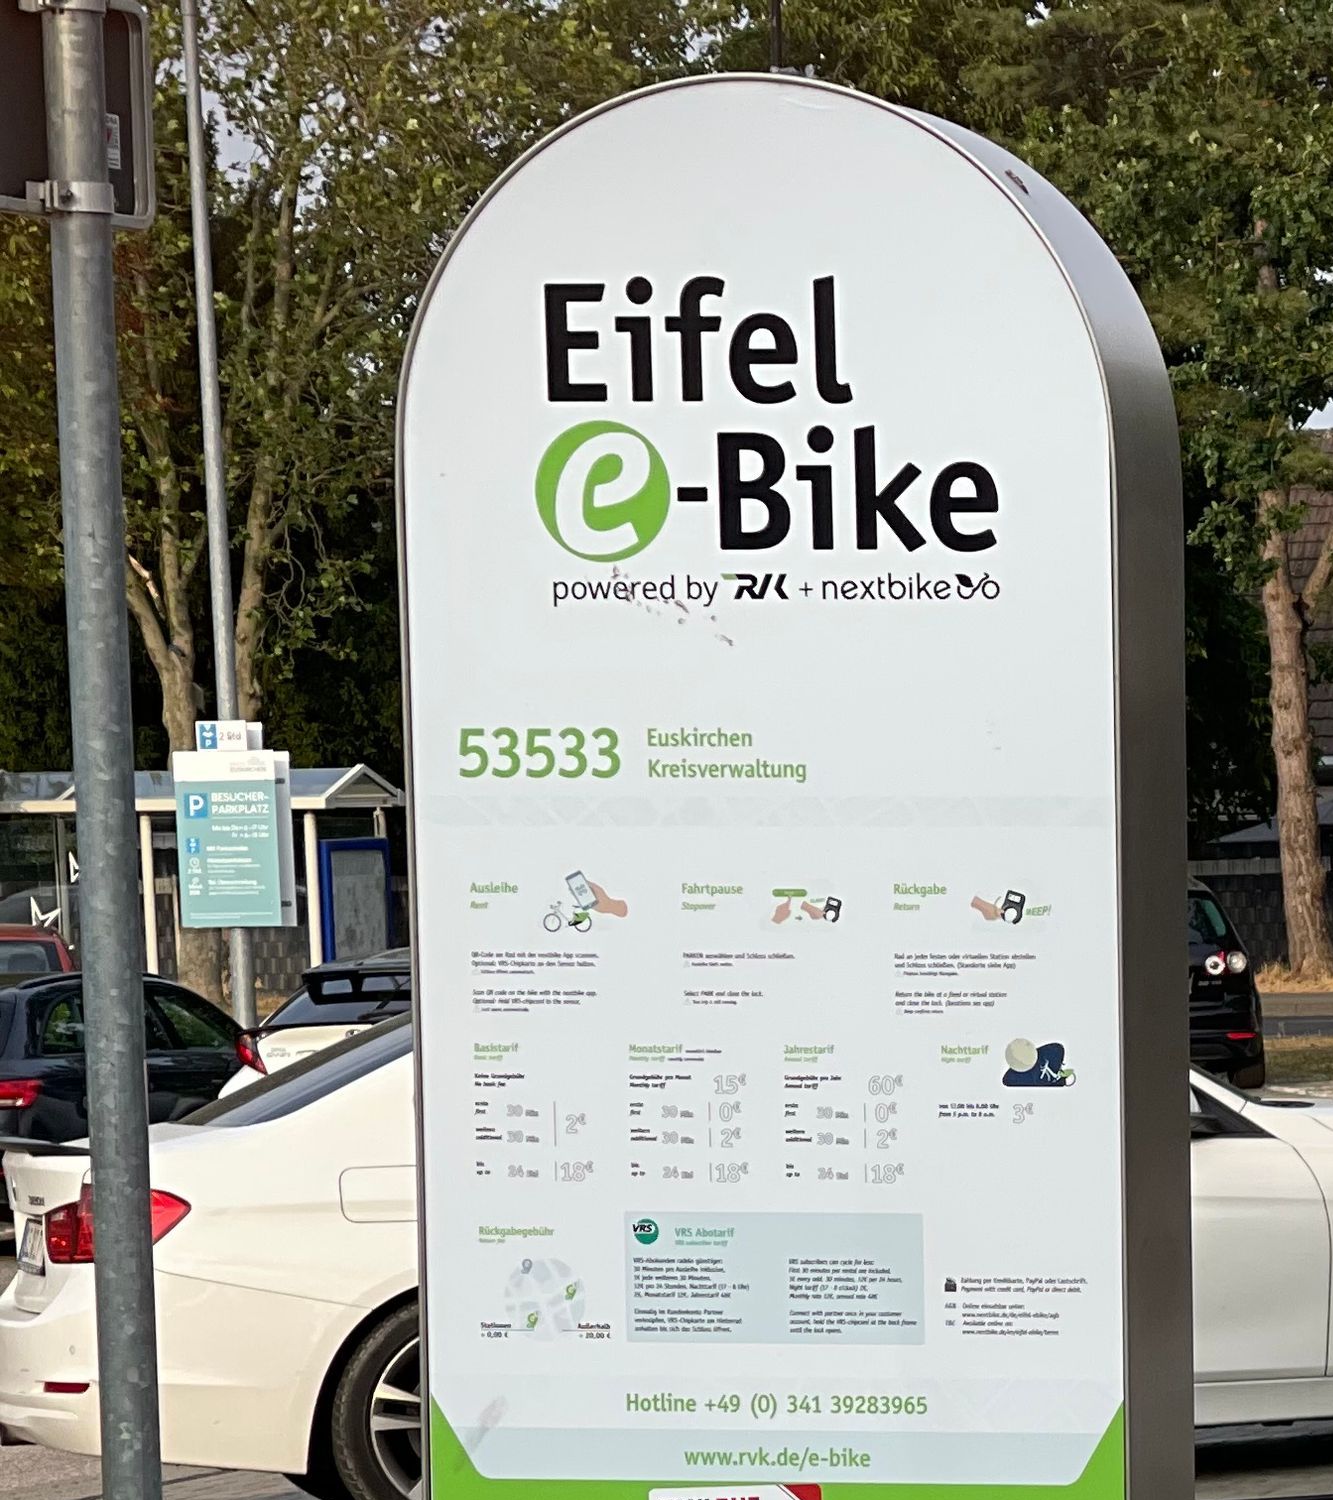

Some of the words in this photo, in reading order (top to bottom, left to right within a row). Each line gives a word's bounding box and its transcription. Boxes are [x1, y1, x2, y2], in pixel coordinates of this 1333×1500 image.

[544, 275, 852, 404] Eifel
[535, 420, 999, 562] e-Bike
[553, 576, 675, 605] powered
[686, 575, 718, 606] by
[800, 582, 812, 596] +
[821, 574, 951, 601] nextbike
[219, 732, 224, 740] 2
[647, 728, 752, 748] Euskirchen
[458, 728, 621, 779] 53533
[648, 759, 807, 782] Kreisverwaltung
[211, 792, 269, 802] BESUCHER-
[189, 794, 204, 816] P
[212, 804, 269, 814] PARKPLATZ
[470, 882, 518, 894] Ausleihe
[682, 883, 743, 896] Fahrtpause
[894, 883, 947, 897] Rückgabe
[474, 1043, 518, 1052] Basistarif
[629, 1044, 682, 1053] Monatstarif
[784, 1045, 834, 1054] Jahrestarif
[941, 1045, 989, 1054] Nachttarif
[479, 1227, 554, 1237] Rückgabegebühr
[632, 1224, 652, 1232] VRS
[675, 1228, 692, 1237] VRS
[695, 1228, 734, 1237] Abotarif
[626, 1393, 696, 1412] Hotline
[705, 1395, 740, 1413] +49
[750, 1393, 777, 1418] (0)
[787, 1395, 821, 1413] 341
[831, 1396, 928, 1415] 39283965
[684, 1447, 871, 1471] www.rvk.de/e-bike
